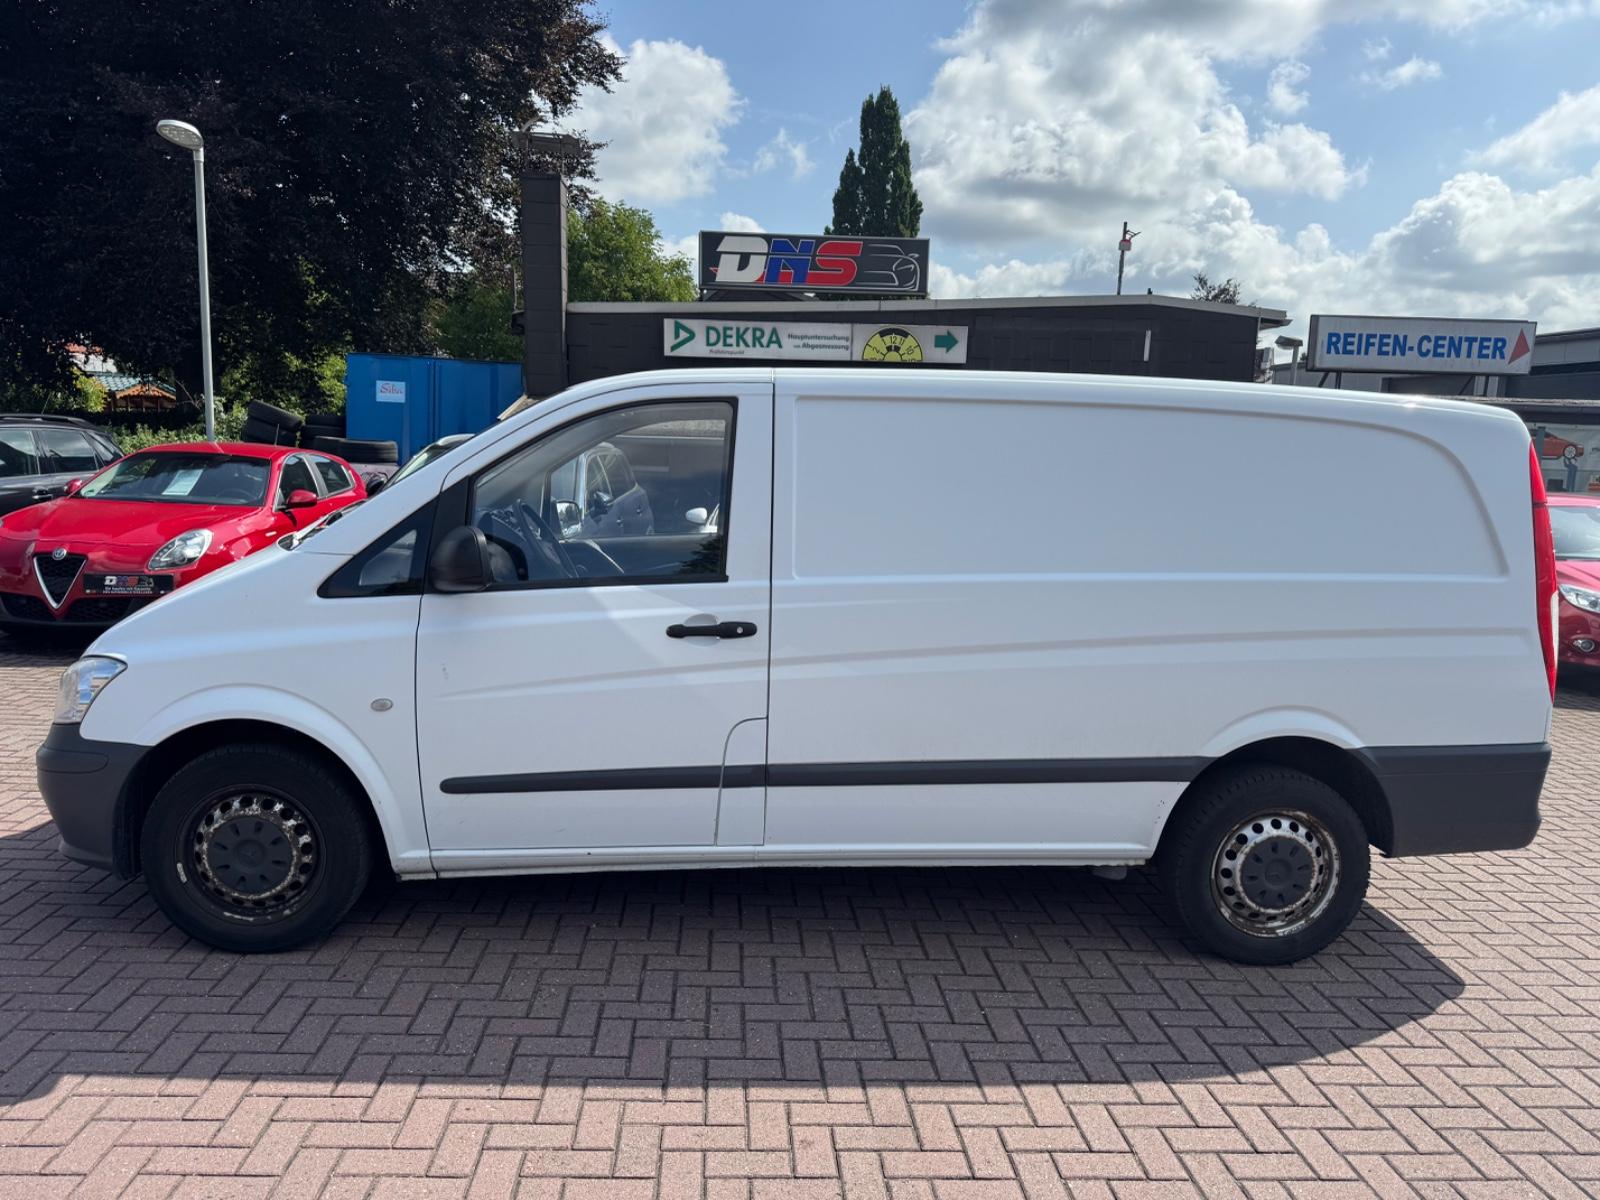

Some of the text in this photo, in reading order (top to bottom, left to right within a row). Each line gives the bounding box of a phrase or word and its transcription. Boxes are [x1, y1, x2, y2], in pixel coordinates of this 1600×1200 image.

[715, 235, 864, 286] DNS
[705, 325, 783, 349] DEKRA
[788, 333, 850, 342] Hauptuntersuchung
[890, 336, 898, 345] 12
[1325, 332, 1508, 360] REIFEN-CENTER
